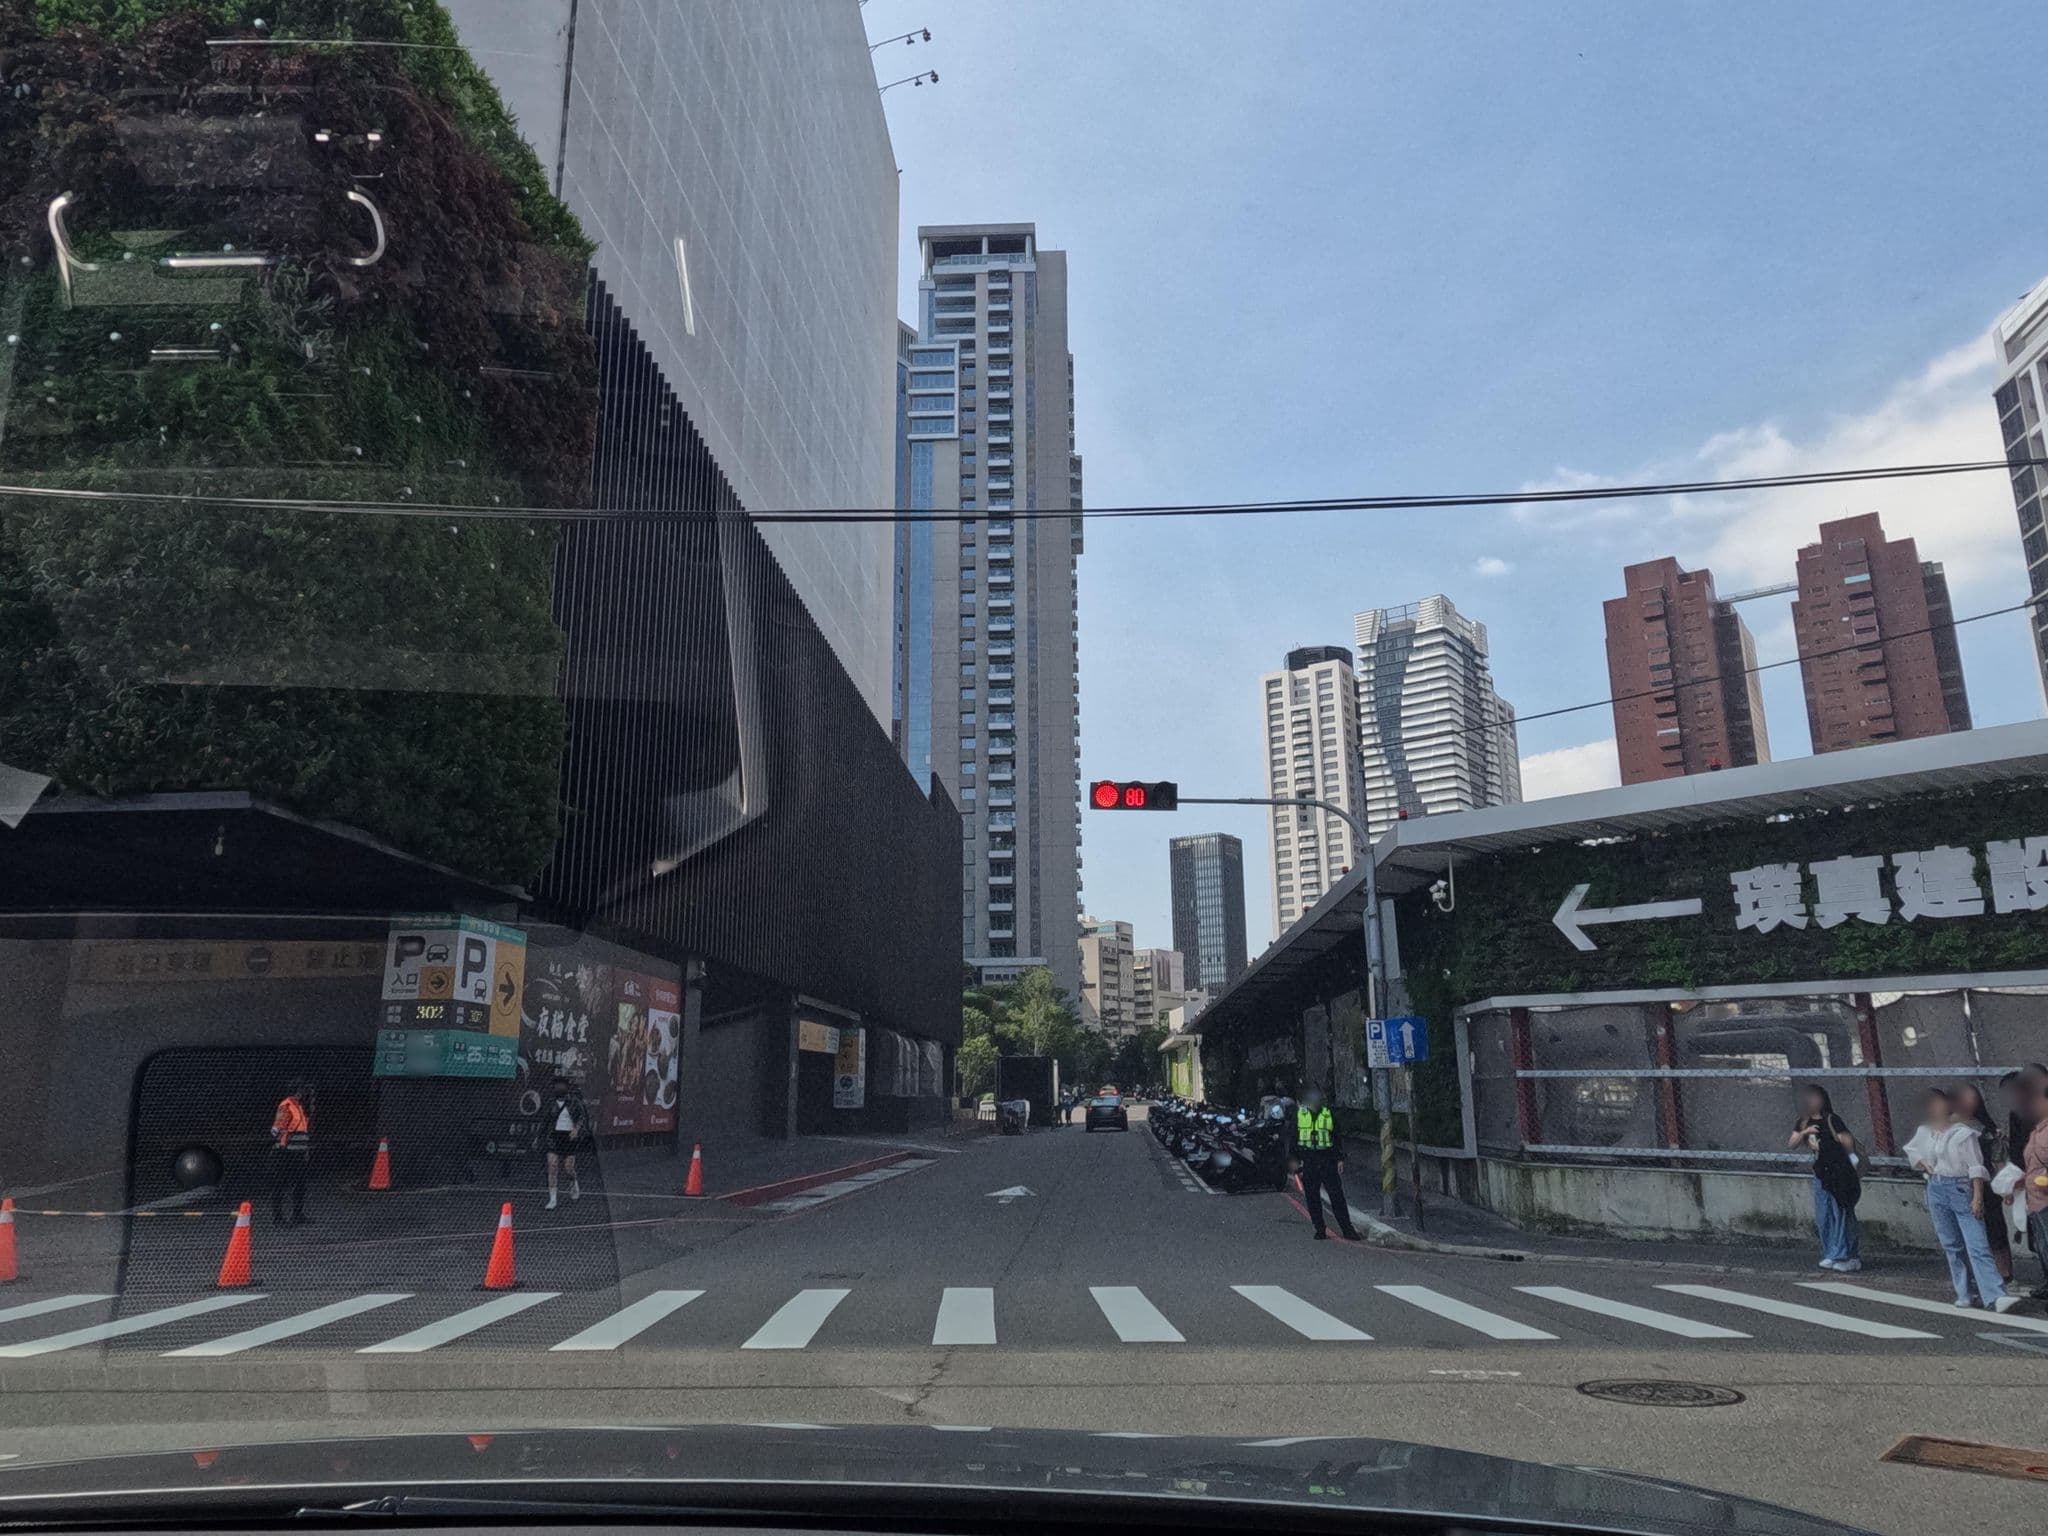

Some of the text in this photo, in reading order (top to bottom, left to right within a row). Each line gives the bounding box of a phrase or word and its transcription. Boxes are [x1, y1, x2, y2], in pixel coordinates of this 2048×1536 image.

[1125, 787, 1145, 807] 80
[1730, 836, 2048, 934] 璞真建設
[394, 936, 426, 968] P
[460, 937, 488, 989] P
[391, 973, 418, 986] 入口
[415, 1005, 445, 1020] 302
[1369, 1022, 1381, 1039] P
